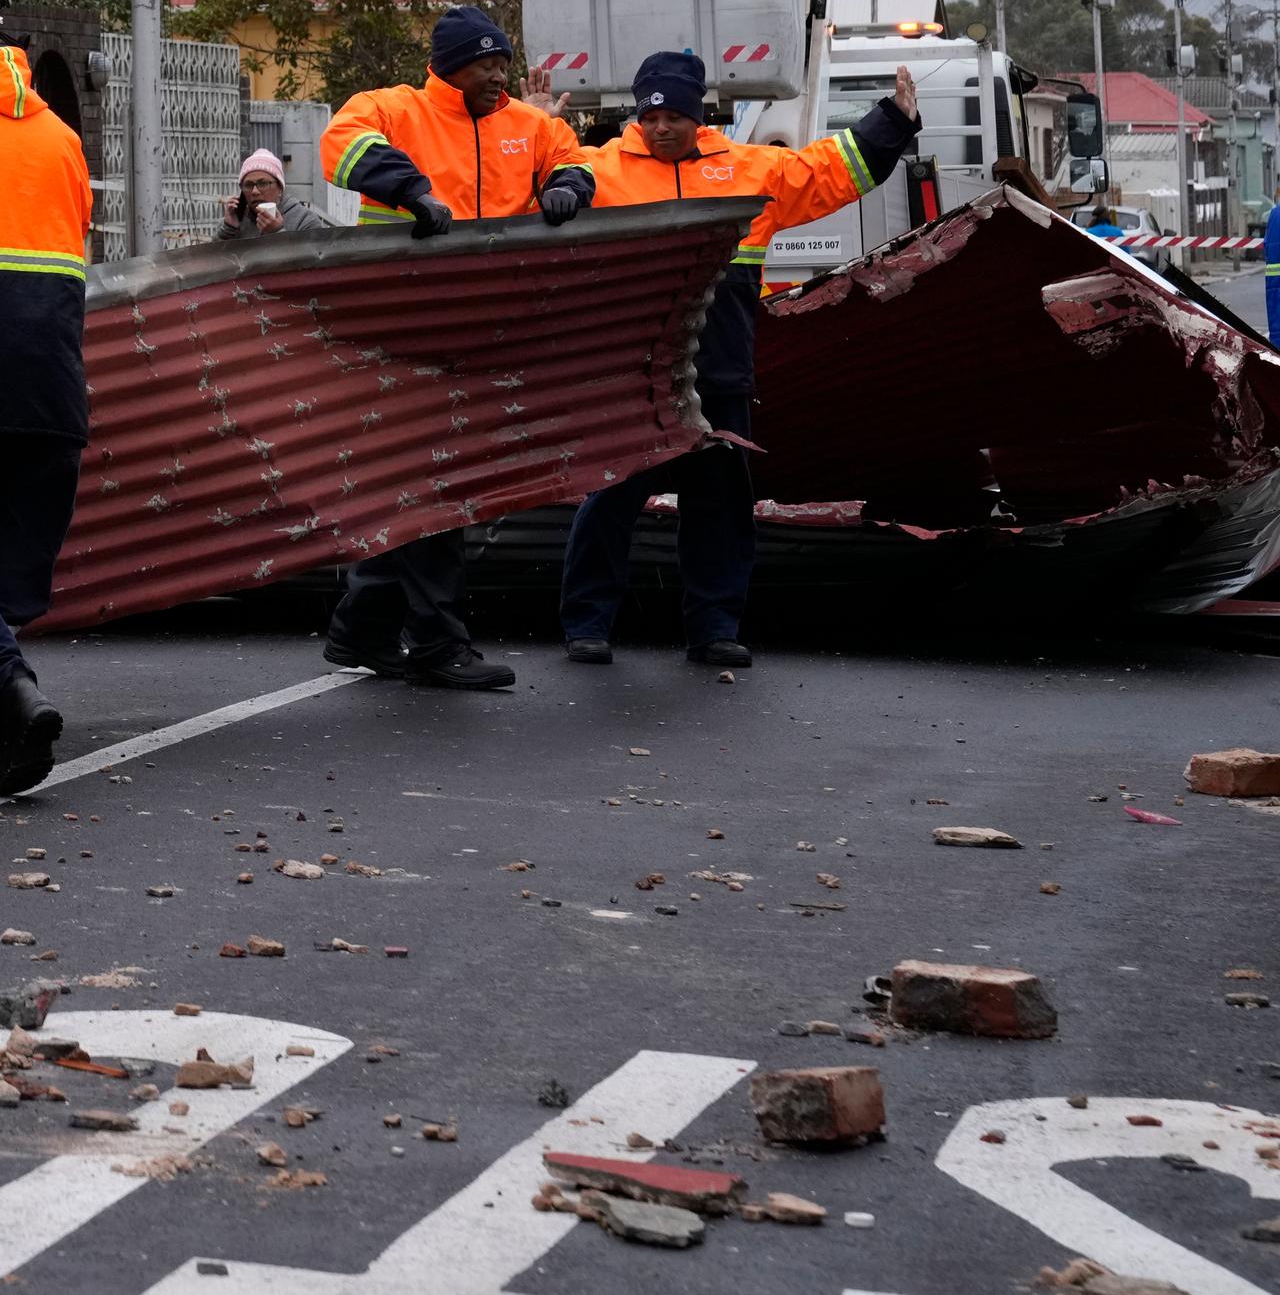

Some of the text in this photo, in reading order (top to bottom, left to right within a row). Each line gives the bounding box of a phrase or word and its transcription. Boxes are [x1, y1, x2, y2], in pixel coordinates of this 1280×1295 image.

[500, 138, 528, 154] CCT
[701, 166, 735, 181] CCT
[785, 240, 840, 251] 0860 125 007
